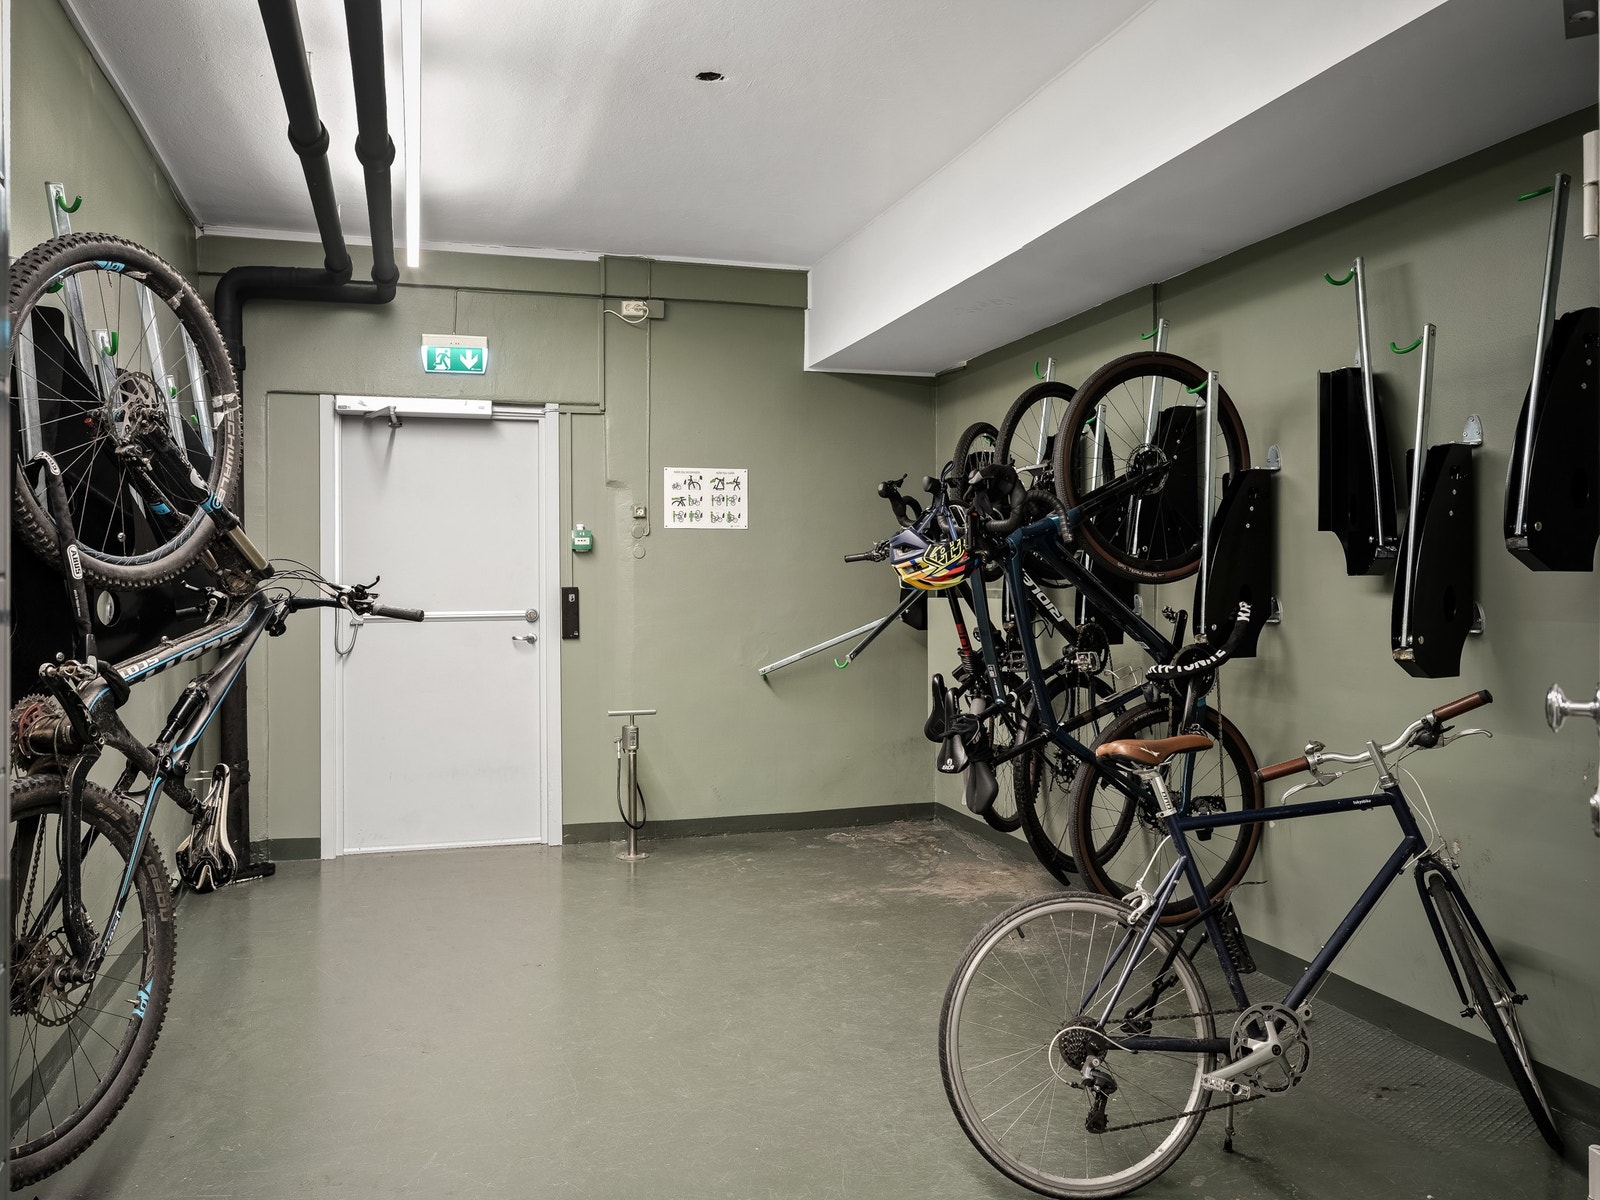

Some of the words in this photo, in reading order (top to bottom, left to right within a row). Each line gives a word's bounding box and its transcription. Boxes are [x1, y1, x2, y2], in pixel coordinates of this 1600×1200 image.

[215, 410, 236, 506] SCHWALB
[69, 547, 82, 577] ABUS
[1022, 566, 1066, 623] RIDLE
[117, 657, 160, 679] SCOT
